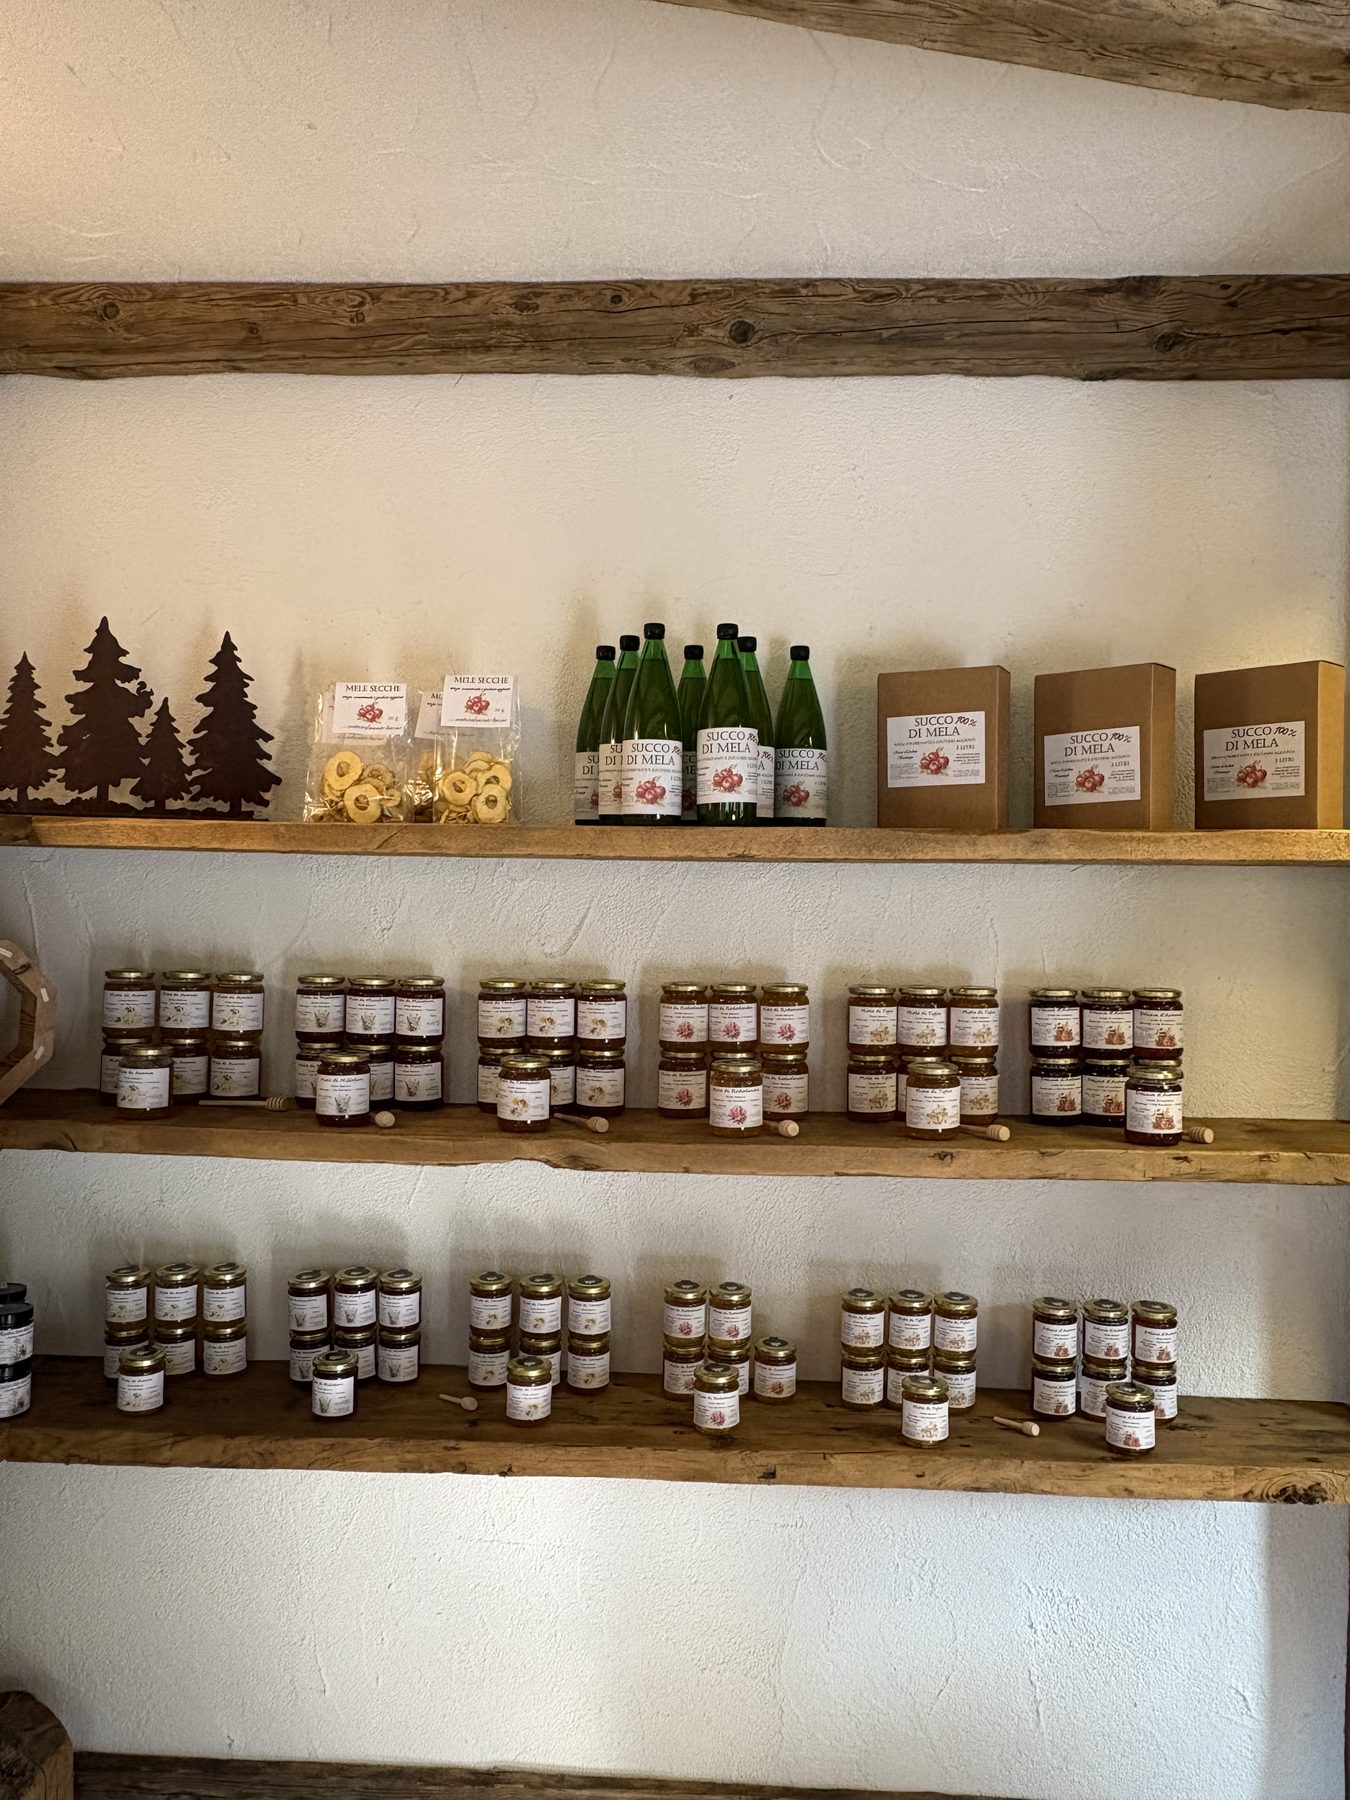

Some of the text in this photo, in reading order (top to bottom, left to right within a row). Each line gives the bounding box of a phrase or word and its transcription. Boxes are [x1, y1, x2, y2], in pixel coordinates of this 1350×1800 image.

[478, 677, 509, 685] SECCHE
[914, 715, 954, 727] SUCCO
[706, 731, 746, 742] SUCCO
[908, 726, 961, 739] DI MELA
[1231, 726, 1272, 739] SUCCO
[1070, 732, 1109, 745] SUCCO
[631, 743, 670, 754] SUCCO
[702, 742, 751, 754] DI MELA
[1064, 743, 1116, 757] DI MELA
[1225, 738, 1279, 752] DI MELA
[779, 749, 815, 759] SUCCO
[605, 756, 617, 766] DI
[627, 755, 637, 765] DI
[641, 755, 676, 766] MELA
[775, 761, 820, 771] DI MELA
[582, 765, 594, 775] DI
